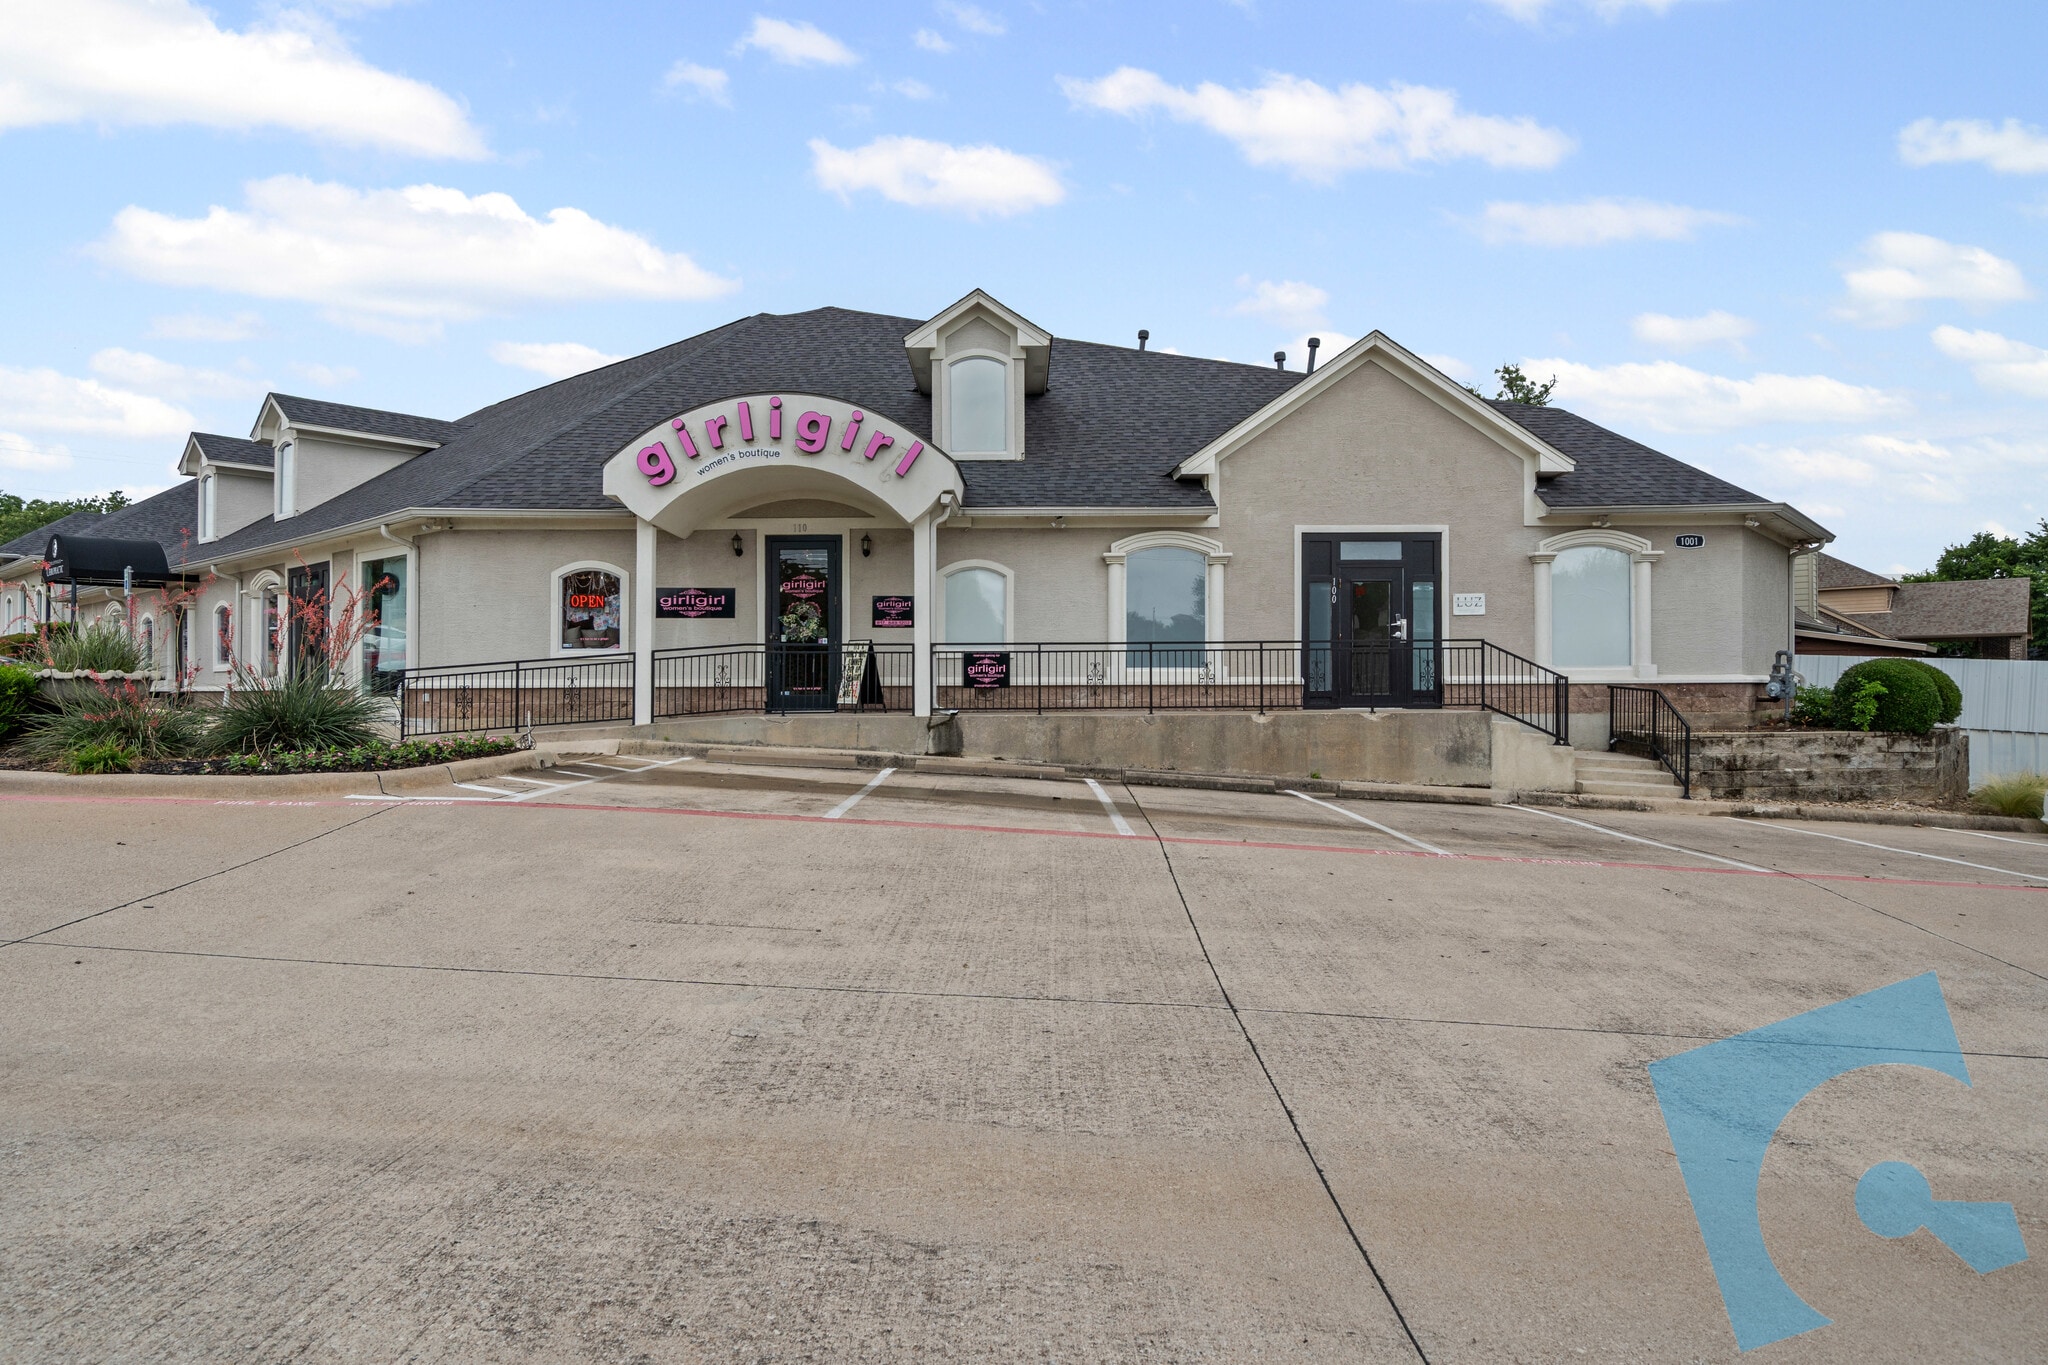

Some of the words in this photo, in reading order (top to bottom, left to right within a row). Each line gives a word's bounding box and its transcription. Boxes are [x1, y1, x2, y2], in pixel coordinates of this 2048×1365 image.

[636, 396, 924, 486] girligirl
[697, 453, 736, 476] women's
[738, 448, 781, 458] boutique
[793, 523, 807, 533] 110
[1681, 537, 1698, 546] 1001
[782, 580, 826, 590] girligirl
[571, 594, 605, 608] OPEN
[660, 595, 725, 607] girligirl
[1457, 596, 1483, 607] LUZ
[967, 664, 1006, 674] girligirl
